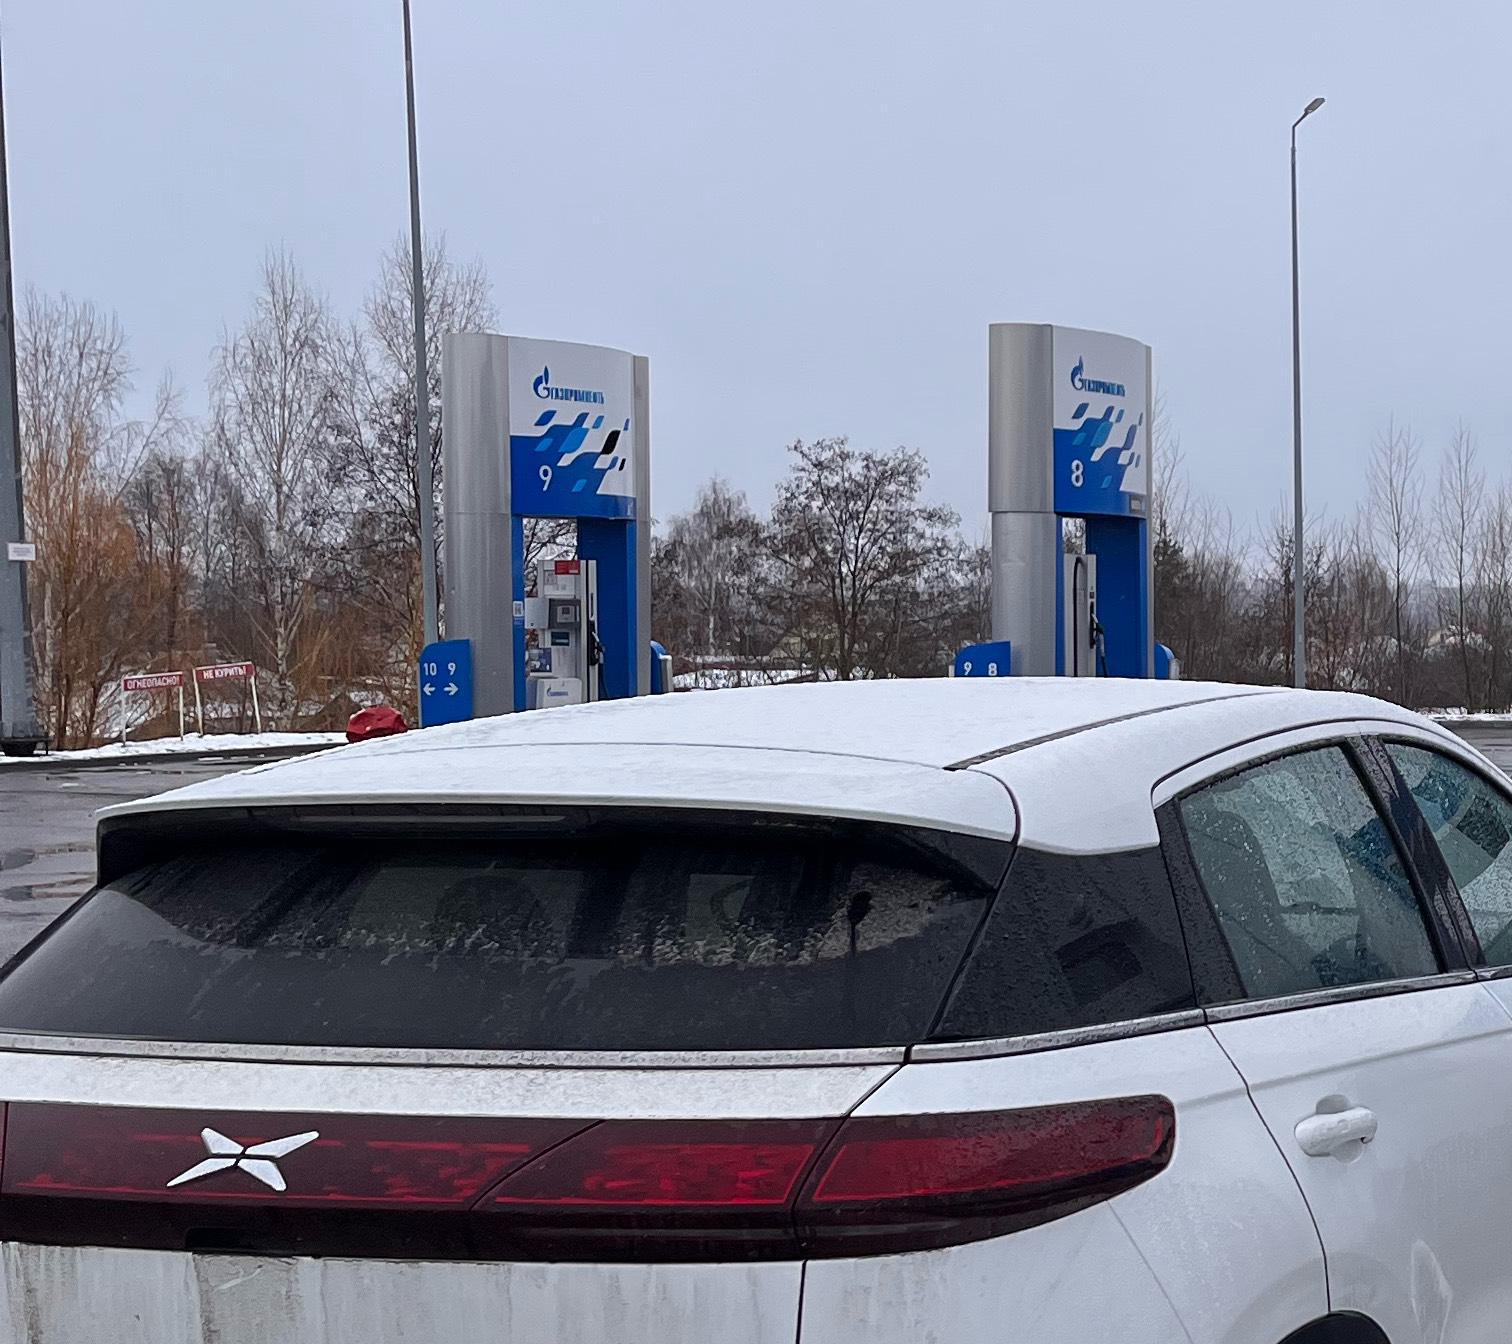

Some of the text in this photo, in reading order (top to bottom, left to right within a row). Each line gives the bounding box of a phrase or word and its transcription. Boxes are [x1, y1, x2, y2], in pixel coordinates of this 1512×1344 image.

[538, 464, 553, 492] 9
[1071, 459, 1084, 488] 8
[423, 662, 456, 676] 10 9
[963, 661, 997, 676] 9 8
